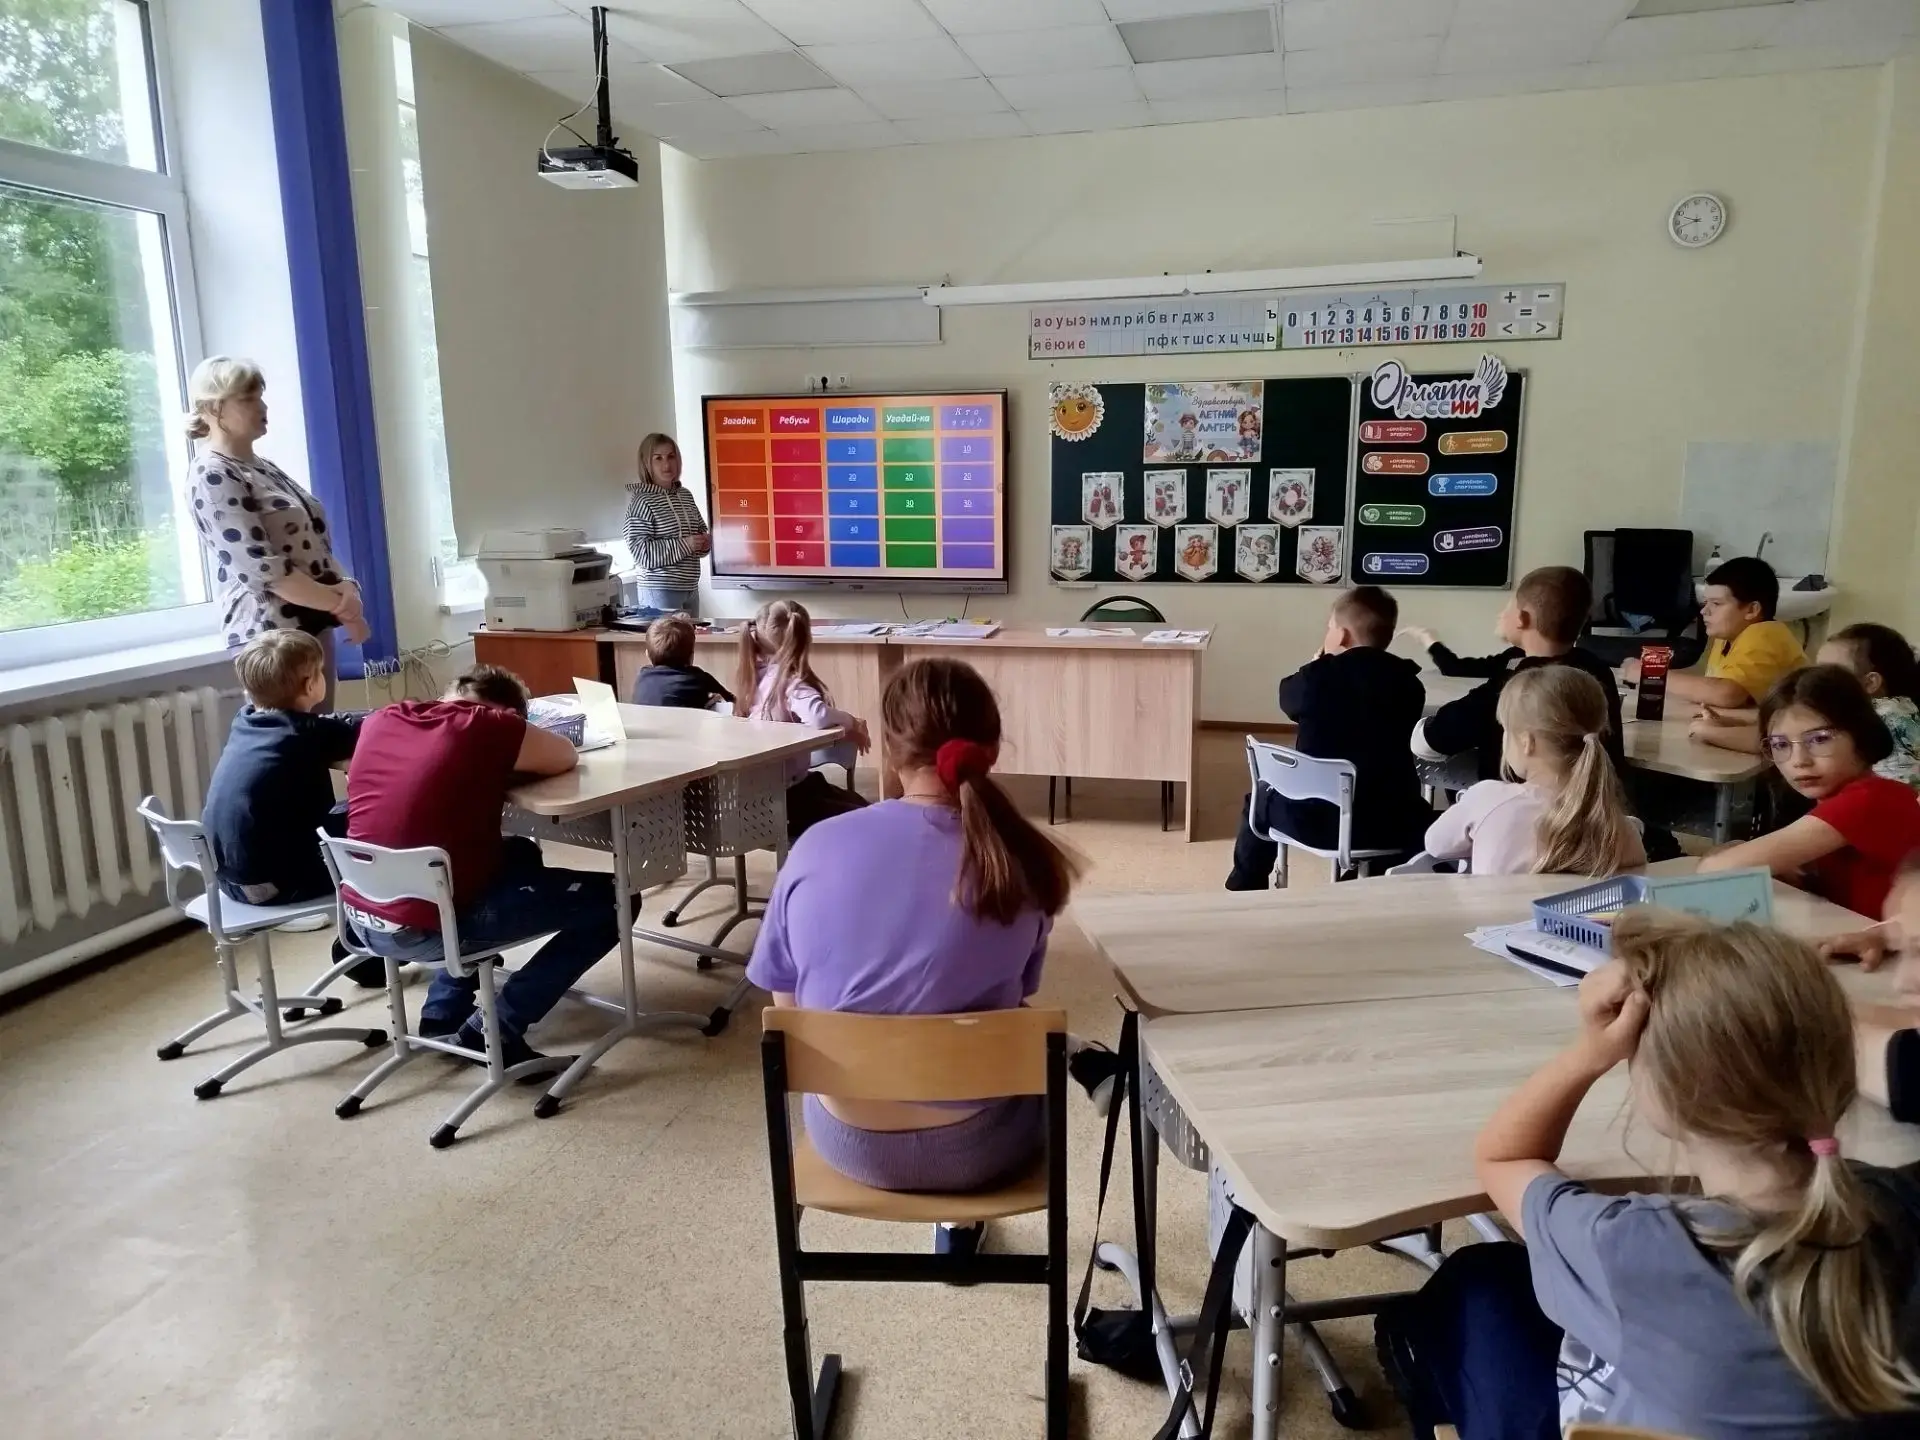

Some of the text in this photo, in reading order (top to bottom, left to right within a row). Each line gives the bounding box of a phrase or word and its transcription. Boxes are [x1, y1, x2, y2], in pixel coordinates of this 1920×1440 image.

[1288, 303, 1487, 327] 0 1 2 3 4 5 6 7 8 9 10
[1304, 322, 1486, 344] 11 12 13 14 15 16 17 18 19 20
[1373, 361, 1482, 410] Орлята
[1399, 400, 1479, 415] РОССИИ
[886, 413, 930, 423] Угадай-ка
[1199, 408, 1237, 419] ЛЕТНИЙ
[722, 416, 757, 426] Загадки
[779, 416, 810, 426] Ребусы
[832, 415, 869, 426] Шарады
[1199, 422, 1237, 432] ЛАГЕРЬ
